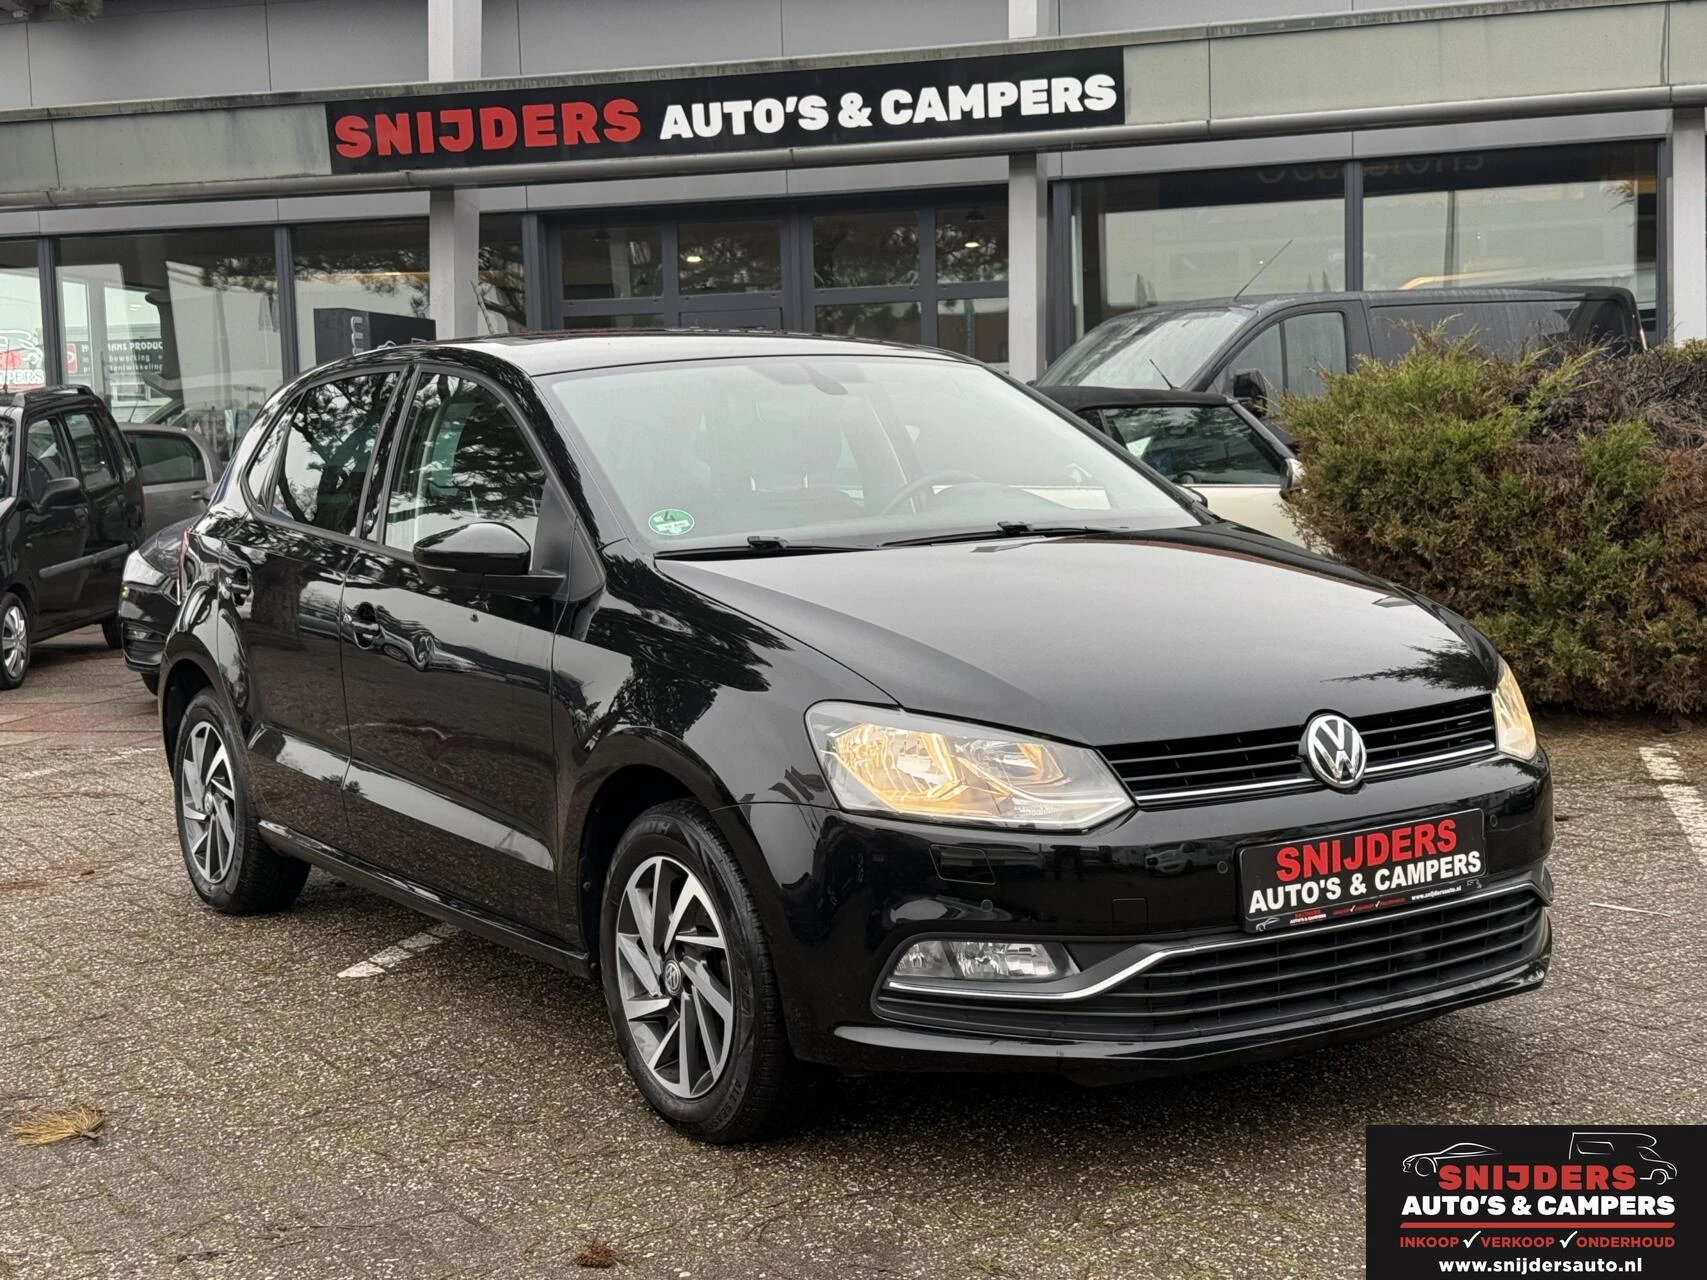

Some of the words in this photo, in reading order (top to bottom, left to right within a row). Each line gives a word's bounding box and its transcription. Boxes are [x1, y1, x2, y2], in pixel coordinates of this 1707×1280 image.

[335, 99, 641, 159] SNIJDERS
[659, 95, 830, 140] AUTO'S
[837, 92, 873, 127] &
[880, 74, 1117, 125] CAMPERS
[1249, 876, 1342, 913] AUTO'S
[1349, 873, 1368, 896] &
[1374, 850, 1482, 889] CAMPERS
[1276, 819, 1458, 882] SNIJDERS
